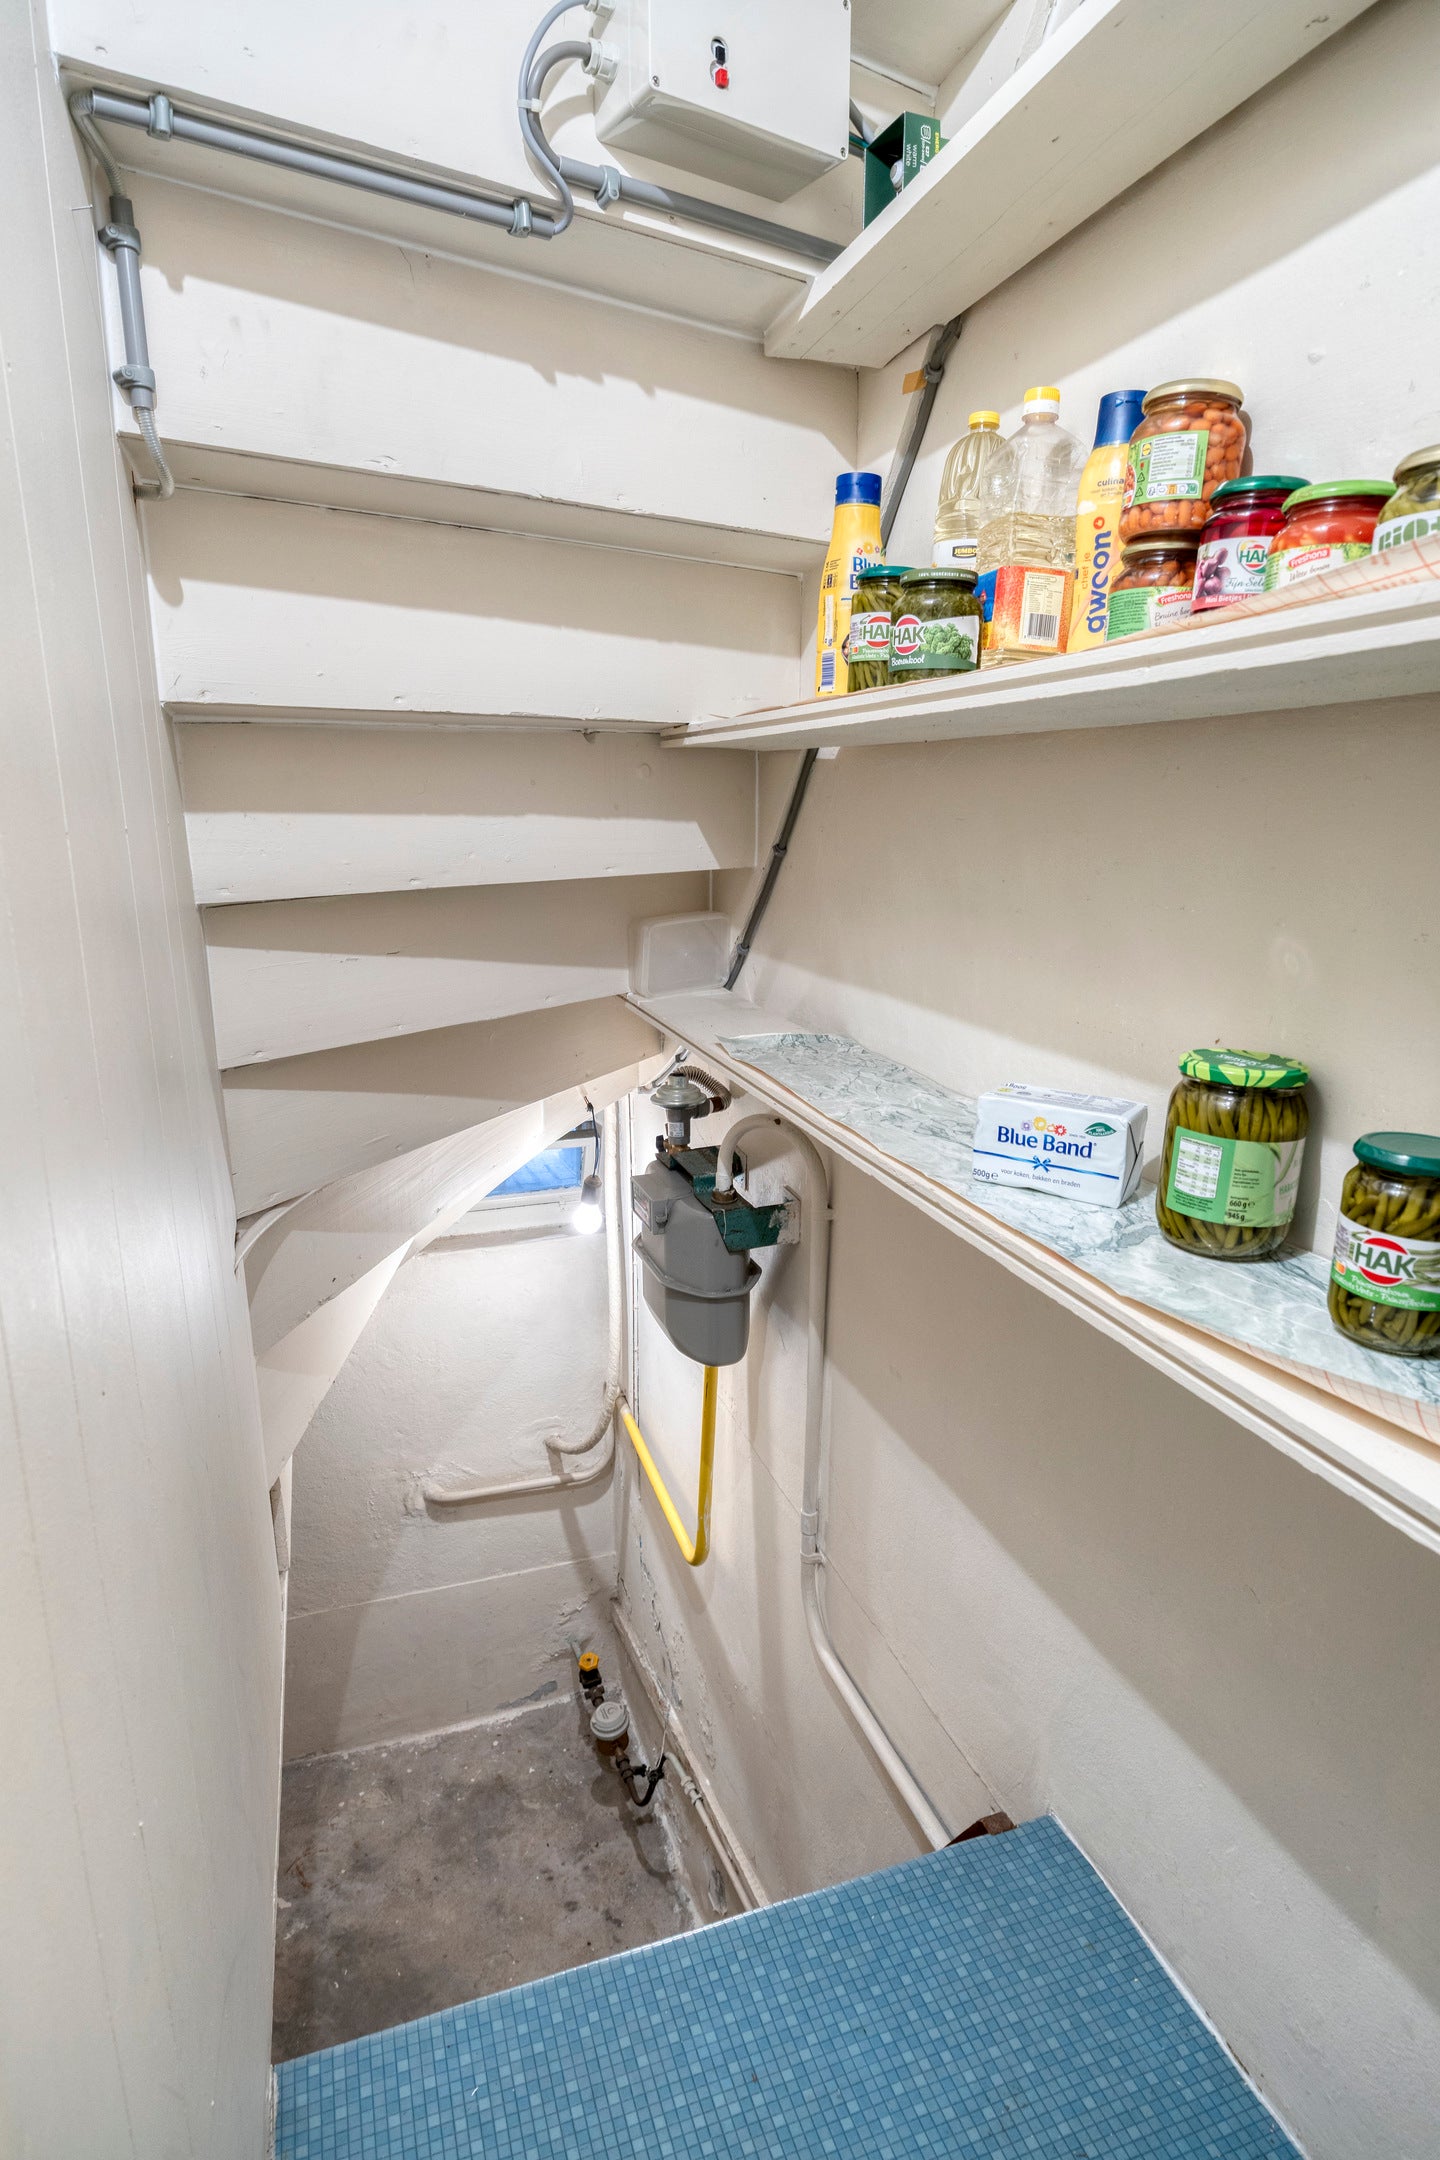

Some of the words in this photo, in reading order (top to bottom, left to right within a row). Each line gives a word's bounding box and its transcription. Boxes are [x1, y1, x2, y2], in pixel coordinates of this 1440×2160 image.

[853, 556, 884, 572] Bl
[1291, 550, 1328, 567] Freshona
[1160, 593, 1192, 604] Freshona
[893, 625, 925, 646] HAK
[997, 1125, 1038, 1149] Blue
[1043, 1134, 1093, 1158] Band
[973, 1168, 990, 1179] 500g
[1032, 1174, 1051, 1182] bakken
[1061, 1179, 1081, 1188] braden
[1354, 1242, 1416, 1279] HAK
